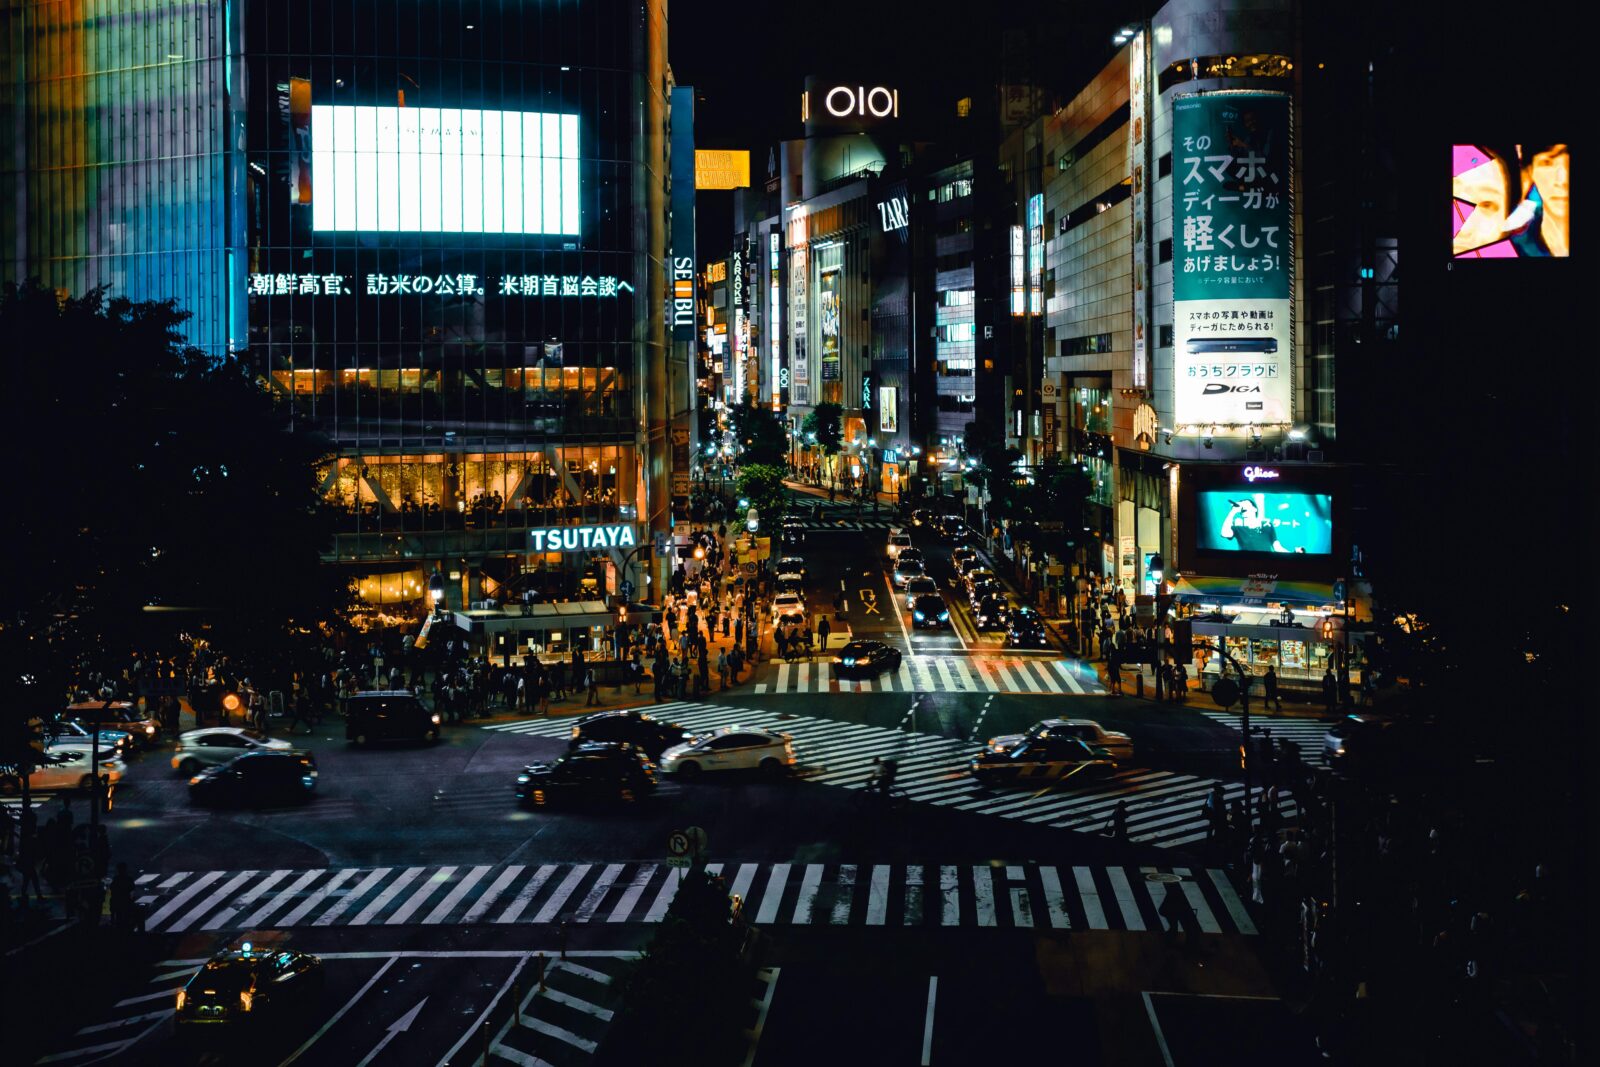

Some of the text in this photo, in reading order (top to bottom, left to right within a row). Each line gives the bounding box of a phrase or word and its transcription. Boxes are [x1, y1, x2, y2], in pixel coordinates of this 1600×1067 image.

[1182, 135, 1211, 152] その
[1182, 151, 1280, 185] スマホ、
[1183, 187, 1280, 212] ディーガが
[877, 196, 909, 232] ZARA
[1183, 215, 1280, 252] 軽くして
[1183, 254, 1281, 273] あげましょう!
[673, 256, 693, 326] SEIBU
[733, 251, 742, 305] KARAOKE
[1189, 310, 1274, 321] スマホの写真や動画は
[1187, 365, 1277, 378] おうちクラウド
[863, 376, 871, 410] ZARA
[1202, 383, 1261, 395] DIGA
[531, 525, 634, 551] TSUTAYA
